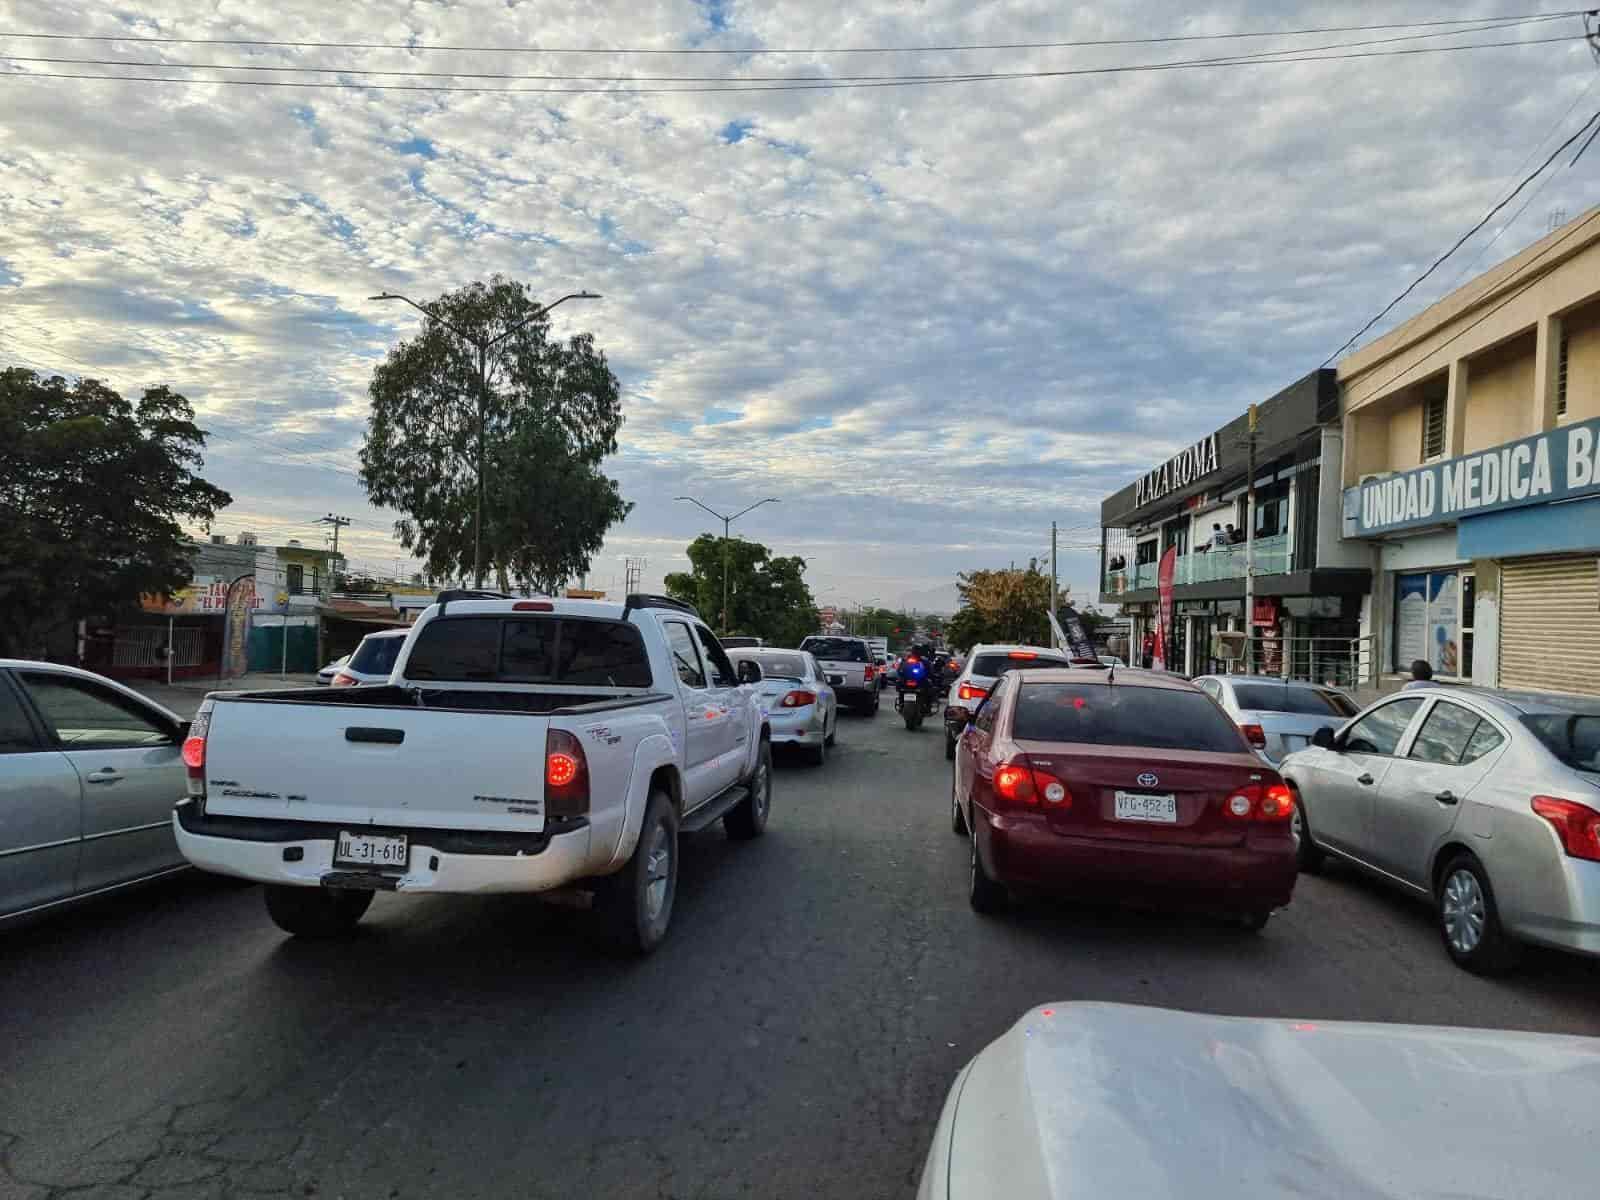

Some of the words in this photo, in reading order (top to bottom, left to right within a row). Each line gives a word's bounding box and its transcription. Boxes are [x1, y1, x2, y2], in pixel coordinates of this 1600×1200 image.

[1135, 463, 1169, 509] PLAZA
[1172, 432, 1218, 489] ROMA
[1362, 470, 1435, 528] UNIDAD
[1442, 437, 1552, 512] MEDICA
[339, 841, 405, 861] UL-31-618
